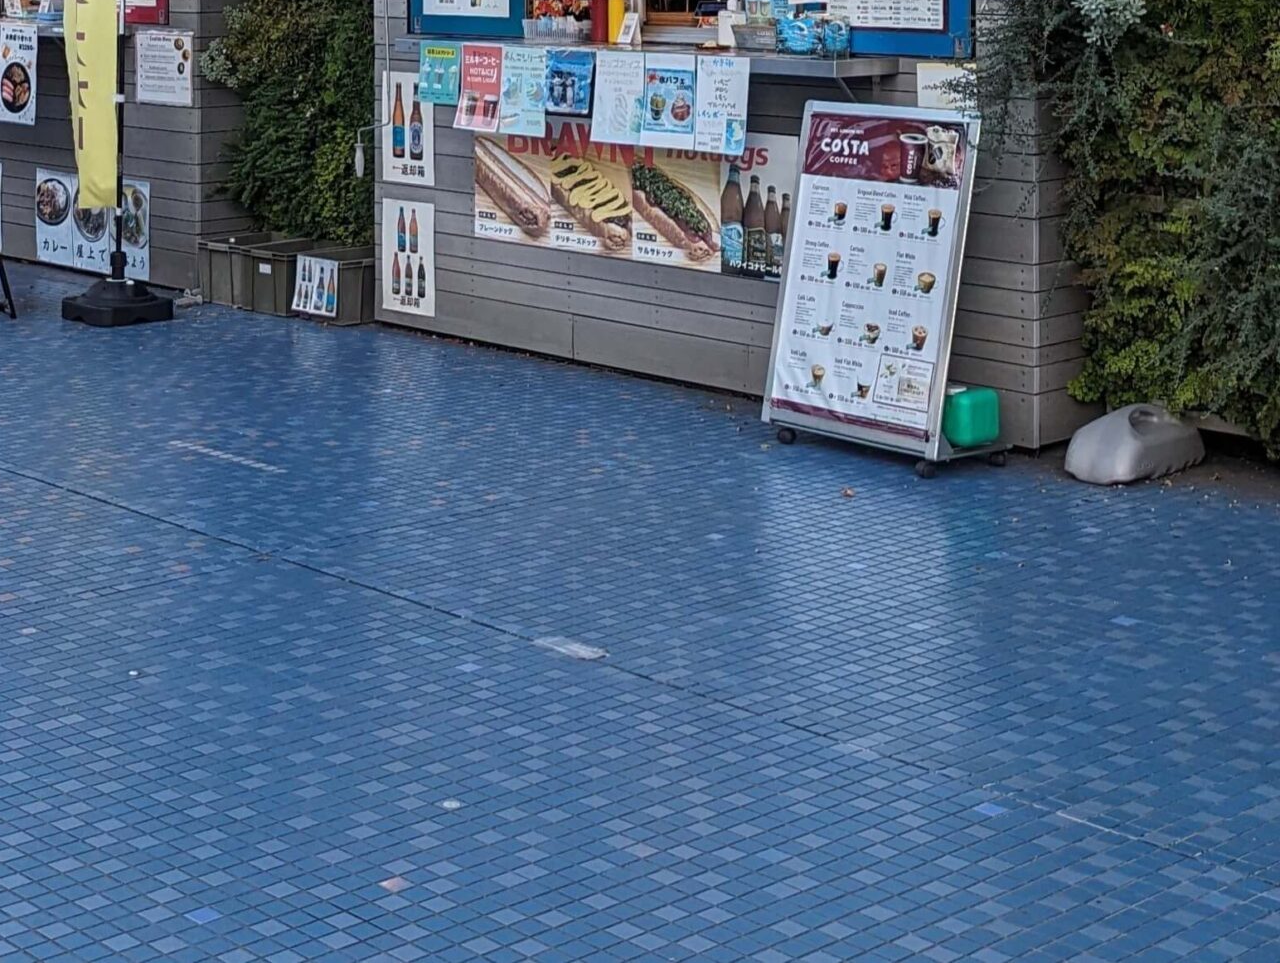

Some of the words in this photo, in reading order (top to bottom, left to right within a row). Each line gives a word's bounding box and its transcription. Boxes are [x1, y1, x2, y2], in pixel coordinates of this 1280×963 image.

[820, 137, 870, 156] COSTA
[829, 155, 858, 165] COFFEE
[906, 149, 915, 175] COSTA
[42, 238, 68, 253] カレー
